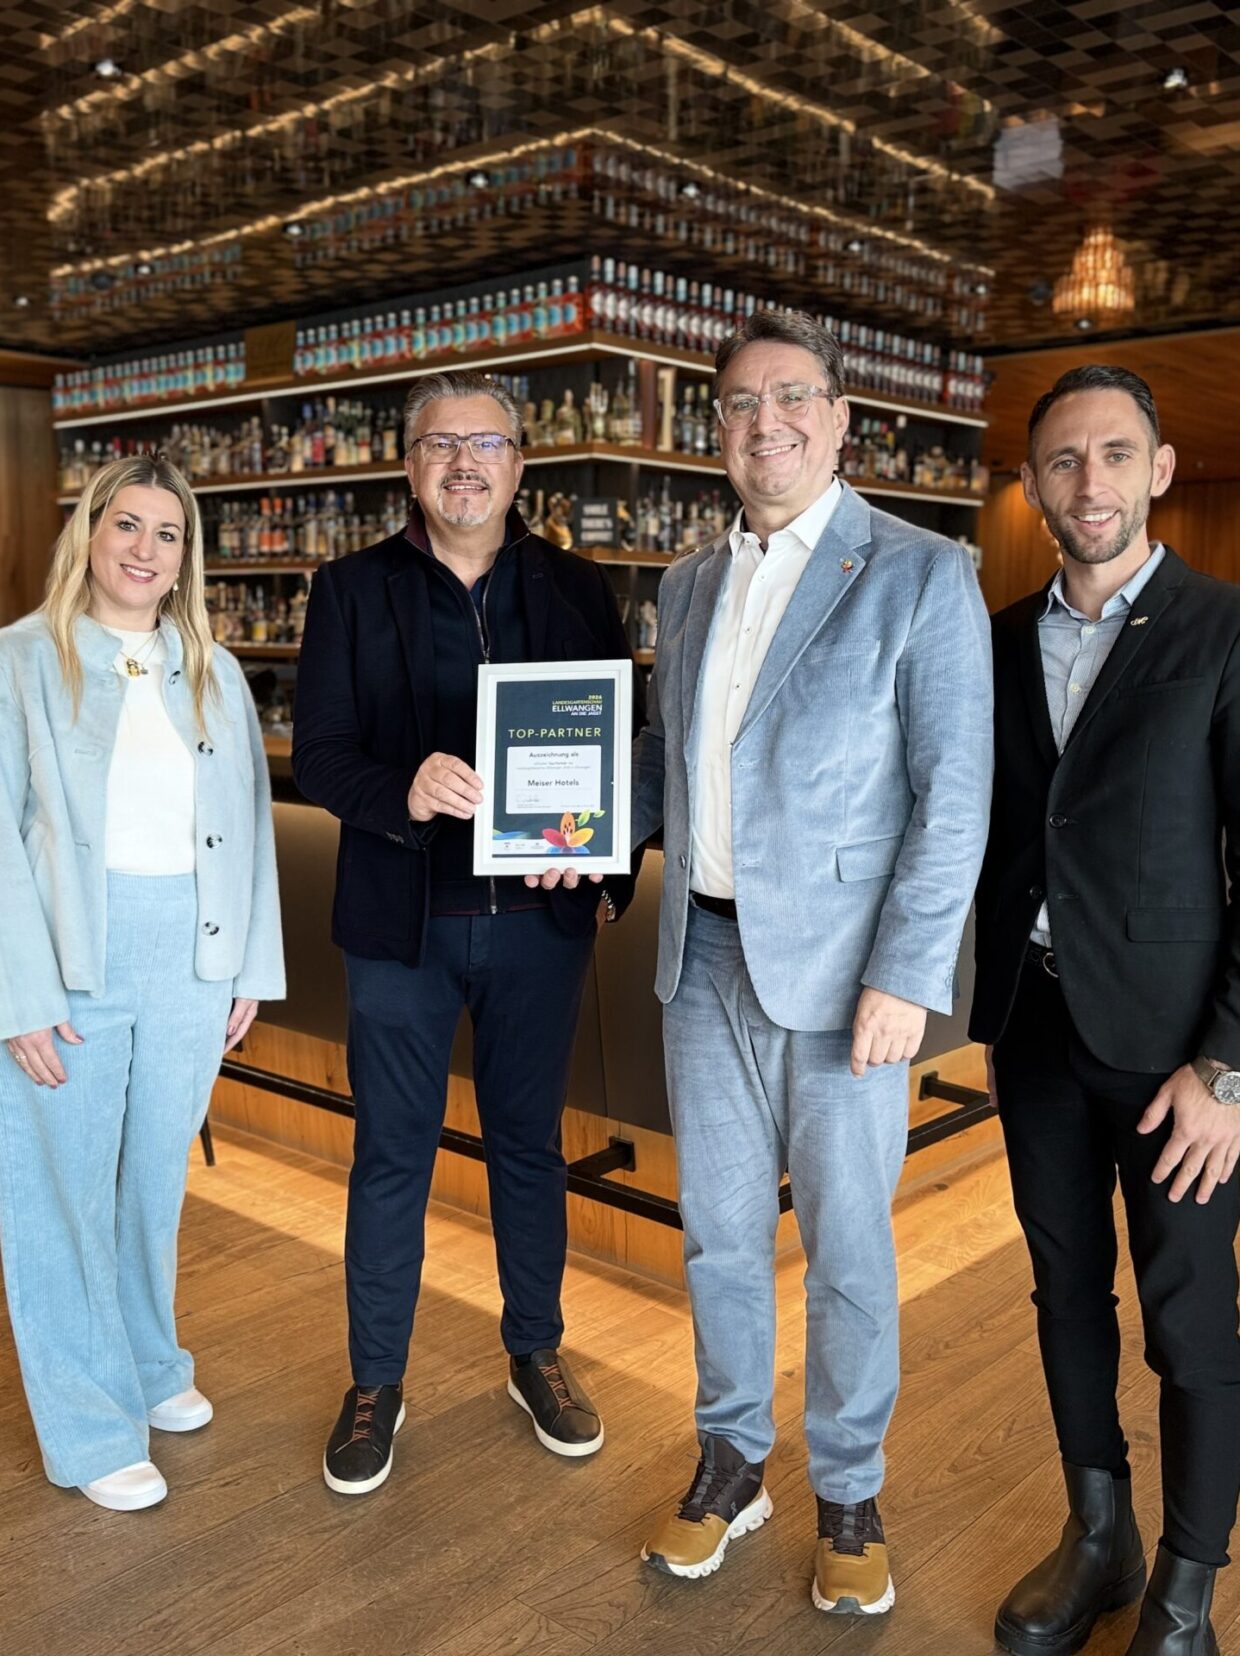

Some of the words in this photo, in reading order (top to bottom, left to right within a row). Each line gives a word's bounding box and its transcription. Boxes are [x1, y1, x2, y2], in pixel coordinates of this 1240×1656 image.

[552, 704, 602, 712] ELLWANGEN
[508, 727, 602, 739] TOP-PARTNER
[528, 779, 552, 787] Meiser
[555, 778, 580, 786] Hotels
